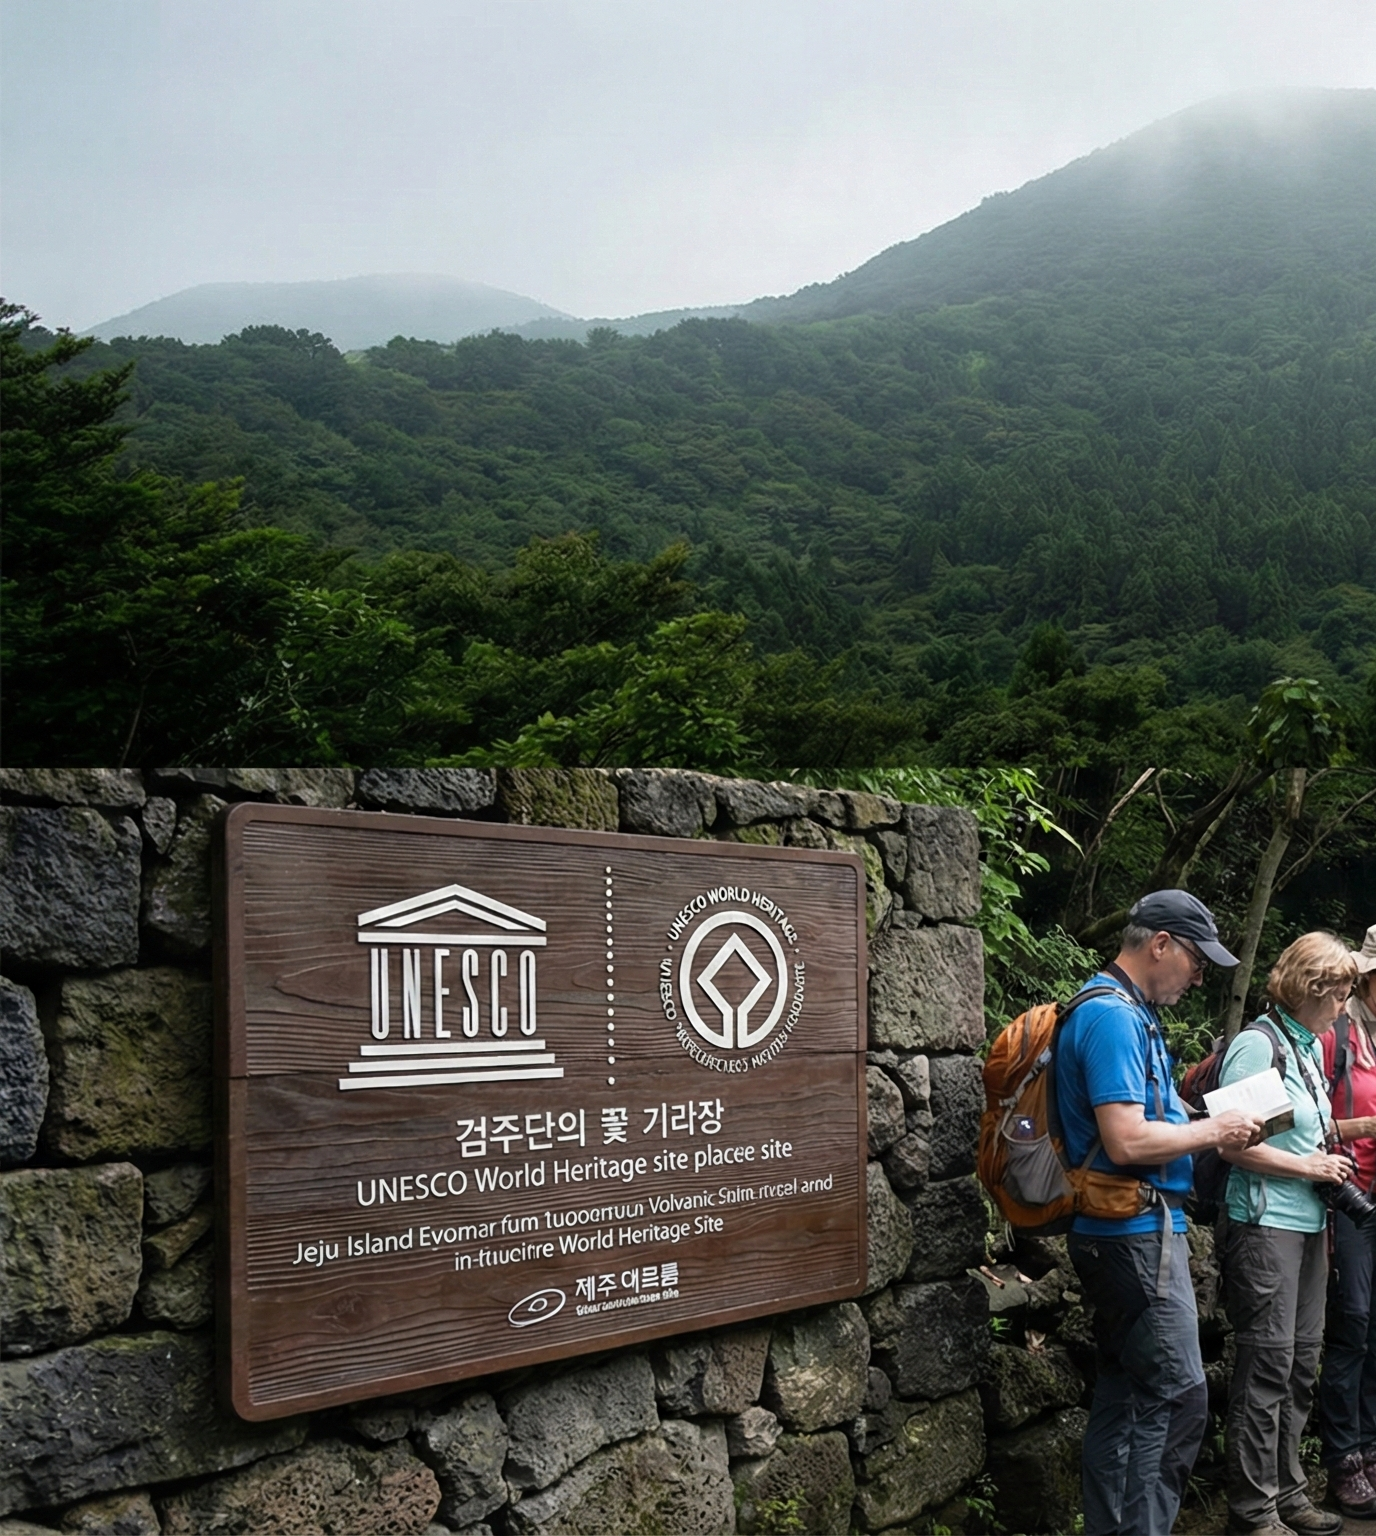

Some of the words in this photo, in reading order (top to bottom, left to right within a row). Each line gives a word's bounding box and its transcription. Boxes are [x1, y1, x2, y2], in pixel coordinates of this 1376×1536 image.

[667, 894, 707, 941] UNESCO
[706, 885, 751, 905] WORLD
[370, 947, 537, 1040] UNESCO
[455, 1108, 586, 1158] 검주단의
[642, 1098, 725, 1139] 기라장
[357, 1170, 468, 1207] UNESCO
[474, 1160, 545, 1193] World
[553, 1156, 648, 1184] Heritage
[653, 1149, 689, 1173] site
[760, 1138, 793, 1160] site
[292, 1240, 339, 1267] Jeju
[347, 1227, 413, 1257] Island
[648, 1190, 716, 1214] Volvanic
[558, 1228, 614, 1255] World
[618, 1222, 691, 1246] Heritage
[694, 1216, 724, 1235] Site
[575, 1273, 618, 1302] 제주
